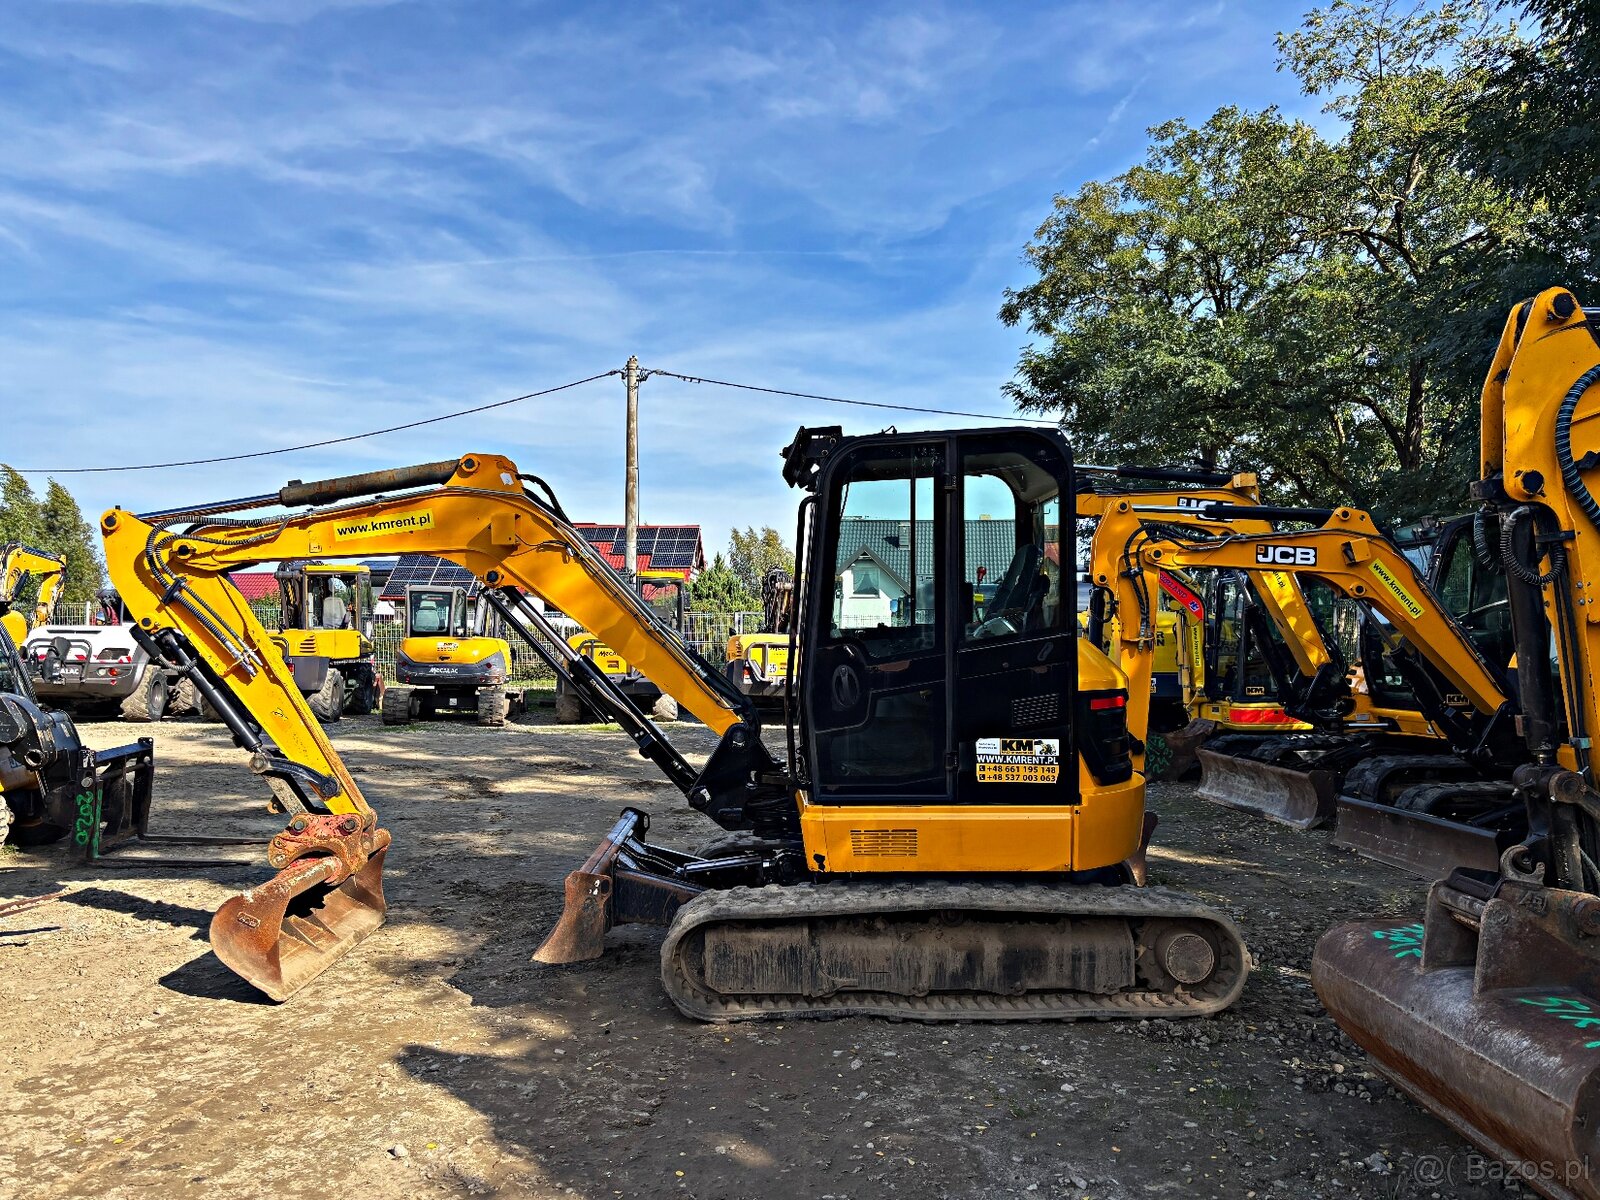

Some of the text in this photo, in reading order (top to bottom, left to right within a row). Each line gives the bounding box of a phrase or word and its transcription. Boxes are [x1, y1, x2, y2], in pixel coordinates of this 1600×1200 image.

[337, 513, 430, 536] www.kmrent.pl
[1257, 546, 1316, 565] JCB
[1373, 563, 1422, 616] www.kmrent.pl
[1001, 739, 1034, 751] KM
[976, 755, 1059, 764] WWW.KMRENT.PL
[987, 765, 1003, 773] +48
[1023, 766, 1039, 774] 195
